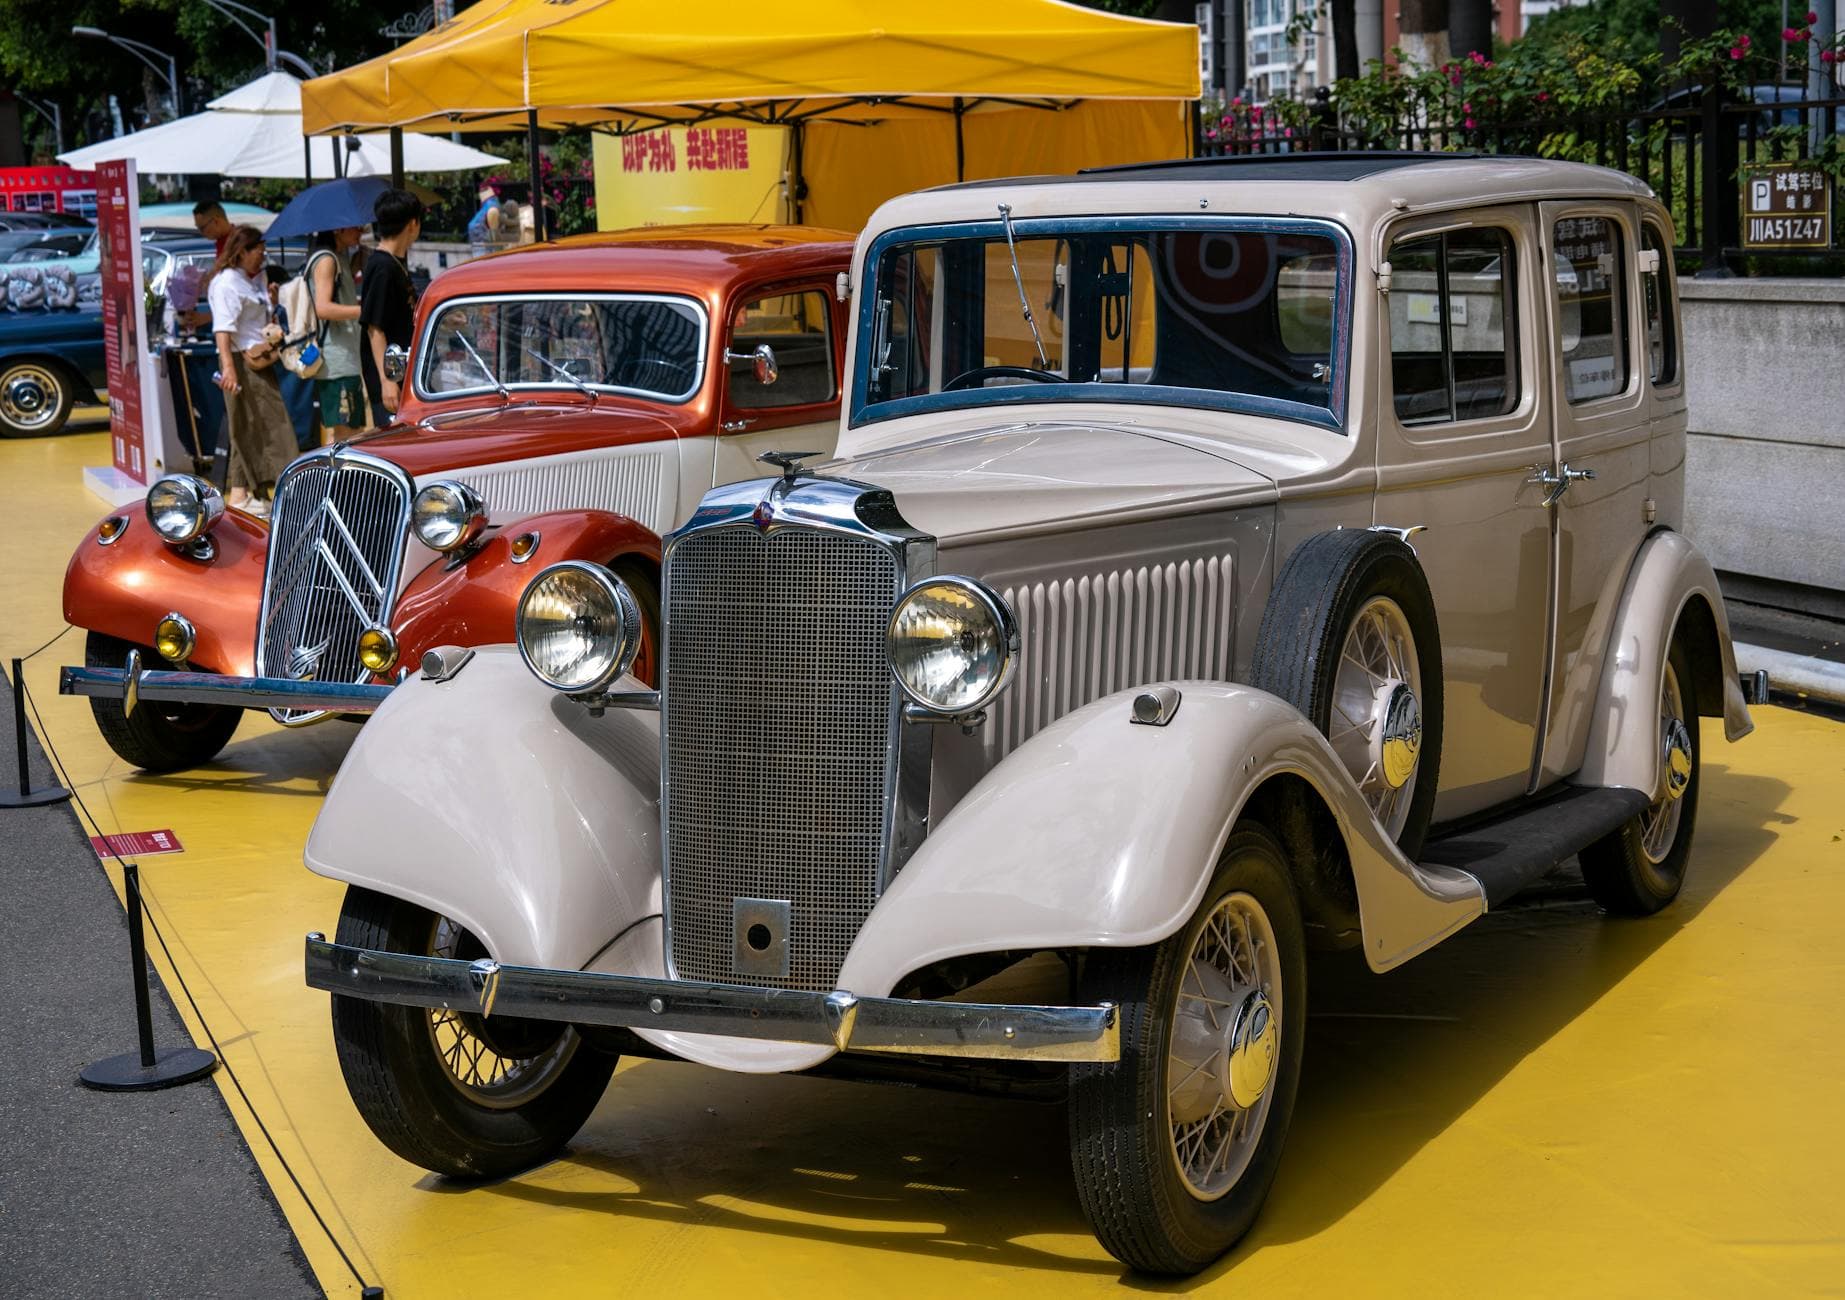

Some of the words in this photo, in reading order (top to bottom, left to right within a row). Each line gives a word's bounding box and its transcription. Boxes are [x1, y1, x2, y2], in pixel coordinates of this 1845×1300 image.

[687, 128, 749, 171] 共赴新程
[1775, 172, 1824, 191] 试驾车位
[1756, 183, 1768, 209] P
